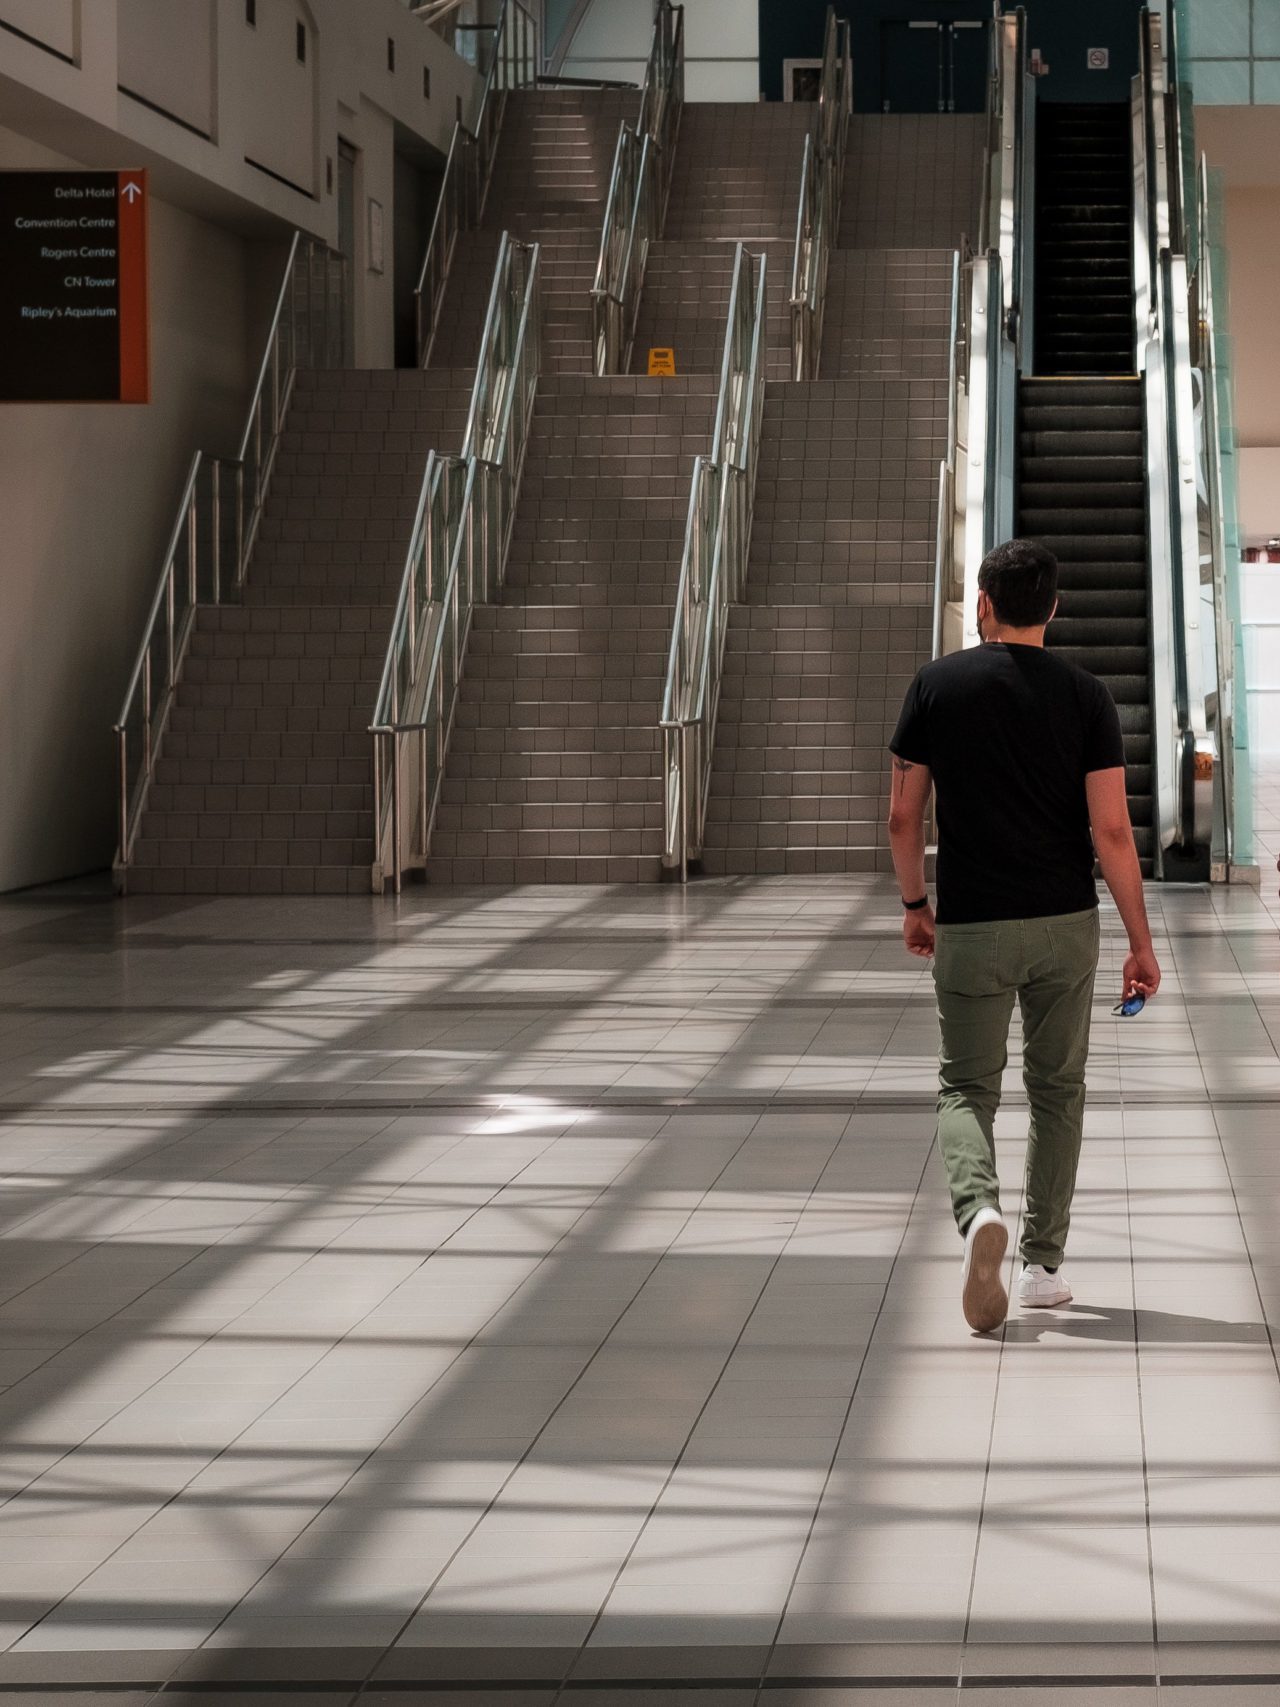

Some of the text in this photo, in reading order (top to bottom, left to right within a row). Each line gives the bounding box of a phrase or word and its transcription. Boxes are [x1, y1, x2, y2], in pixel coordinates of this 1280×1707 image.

[54, 187, 116, 199] Delta Hotel
[15, 216, 116, 228] Convention Centre
[40, 246, 116, 260] Rogers Centre
[64, 276, 117, 287] CN Tower
[21, 306, 117, 319] Ripley's Aquarium
